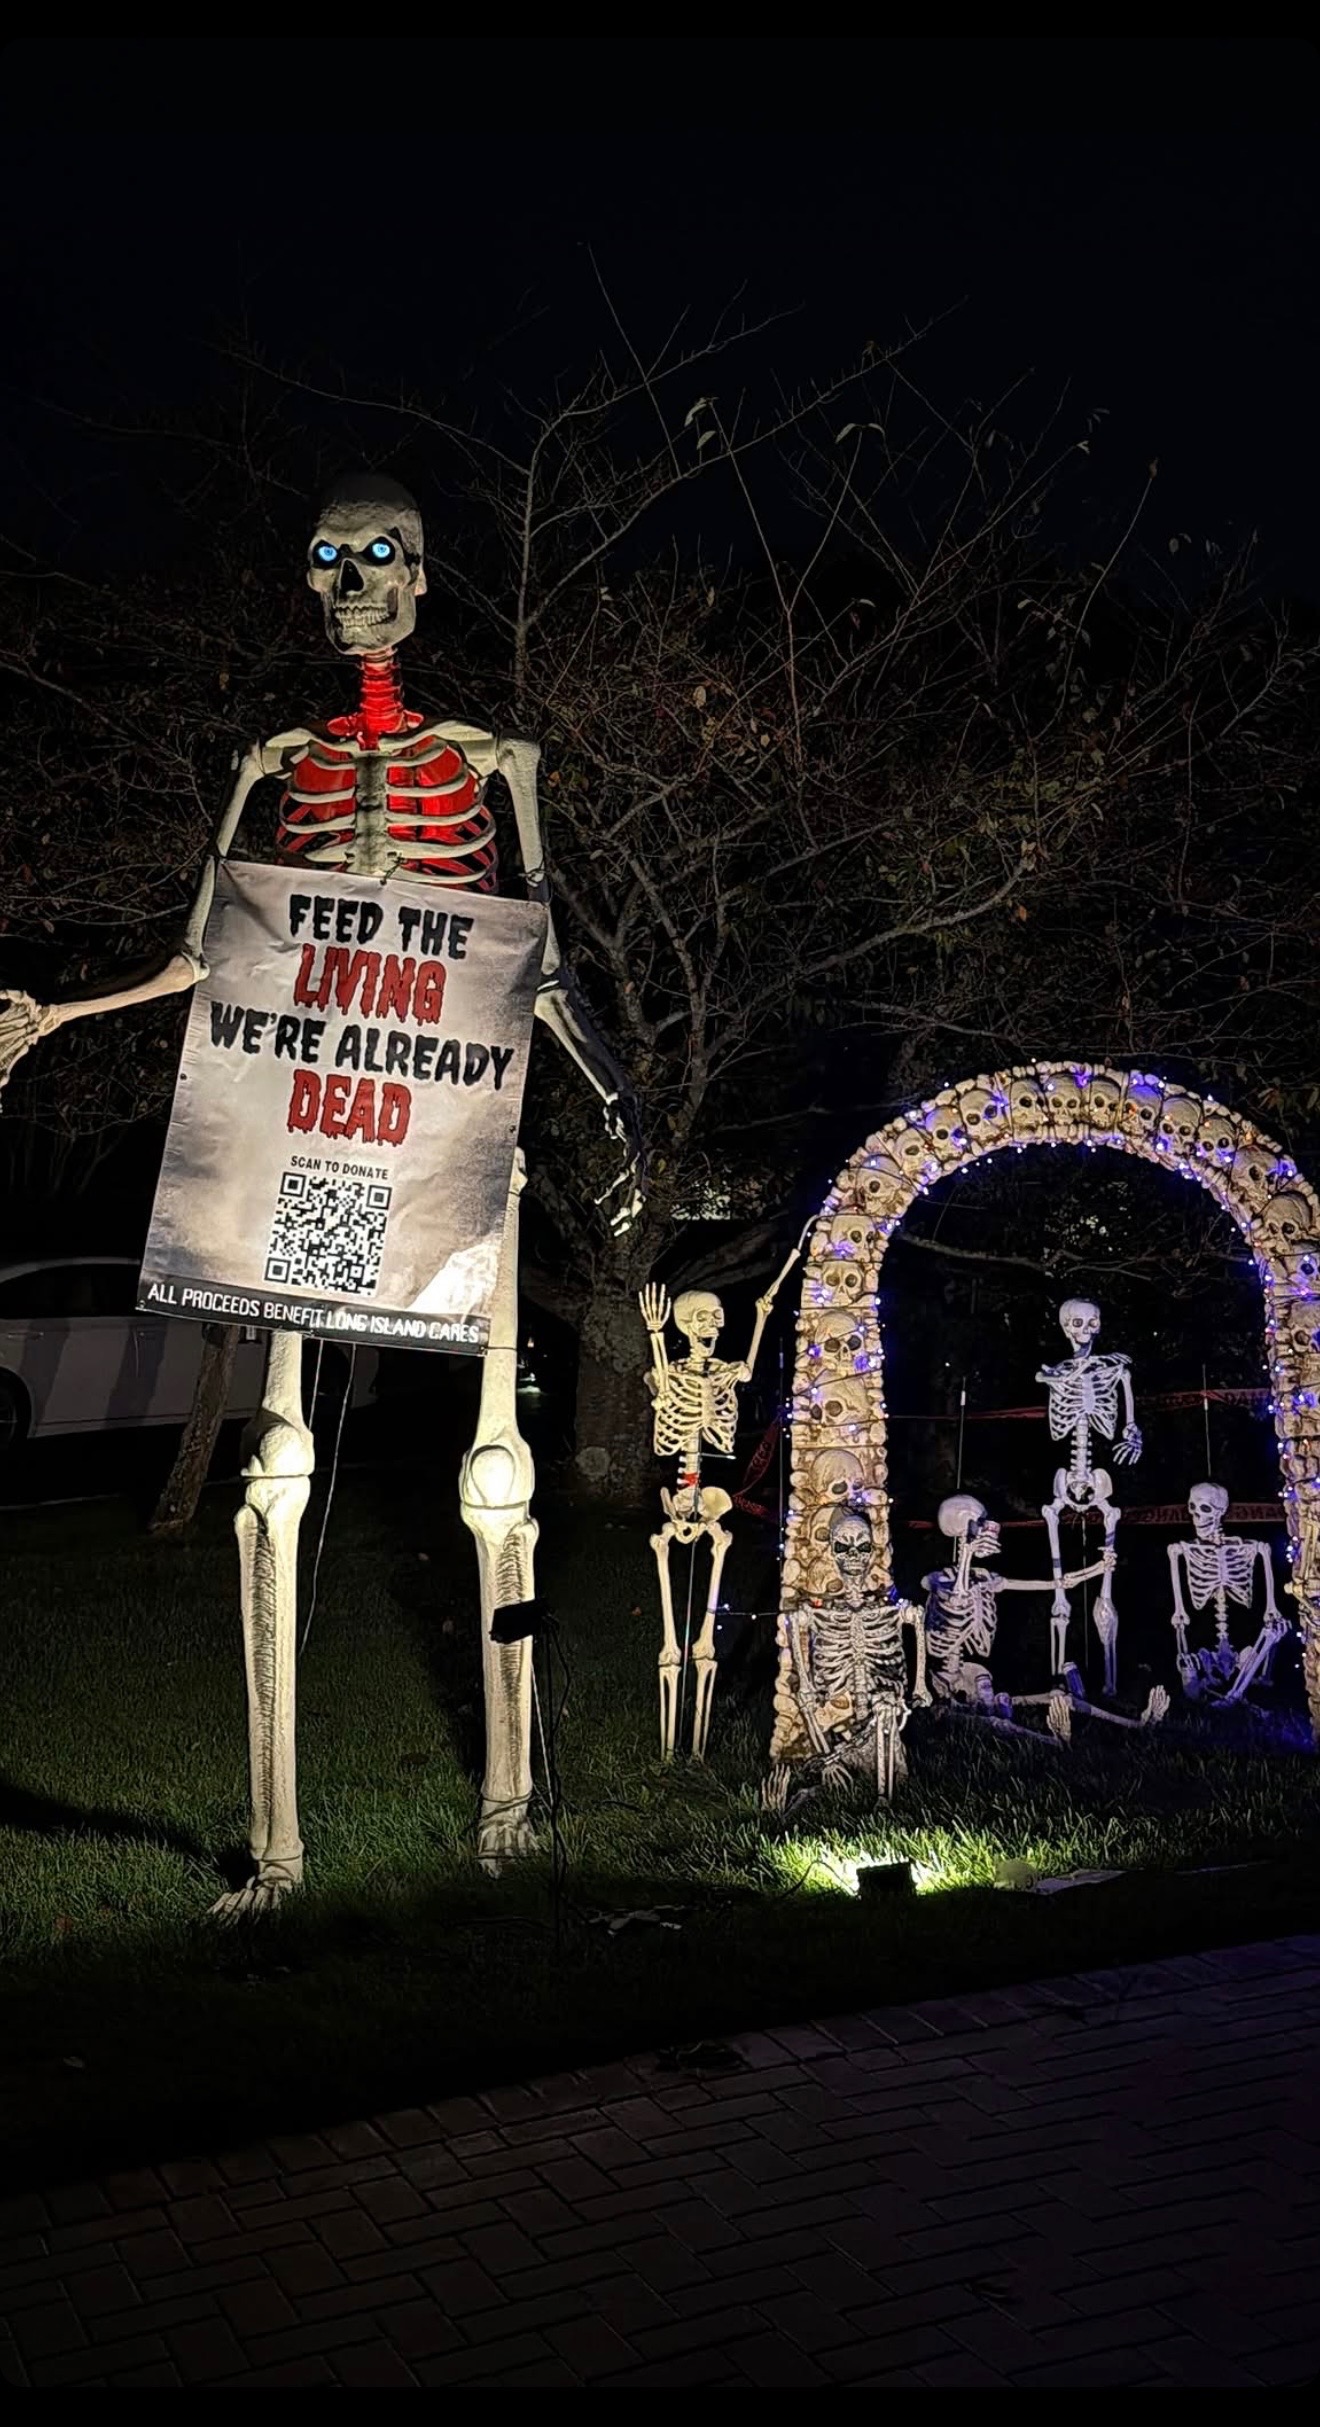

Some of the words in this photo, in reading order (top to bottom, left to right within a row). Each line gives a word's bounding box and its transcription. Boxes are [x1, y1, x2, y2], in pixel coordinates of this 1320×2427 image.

[289, 894, 383, 945] FEED
[399, 906, 474, 960] THE
[293, 944, 447, 1026] LIVING
[210, 1001, 326, 1064] WE'RE
[335, 1025, 515, 1091] ALREADY
[287, 1069, 412, 1146] DEAD
[290, 1155, 321, 1172] SCAN
[325, 1160, 340, 1175] TO
[343, 1163, 389, 1180] DONATE
[148, 1284, 177, 1306] ALL
[182, 1288, 260, 1317] PROCEEDS
[263, 1302, 323, 1328] BENEFIT
[326, 1310, 367, 1331] LONG
[370, 1315, 426, 1338] ISLAND
[428, 1322, 479, 1343] CARES
